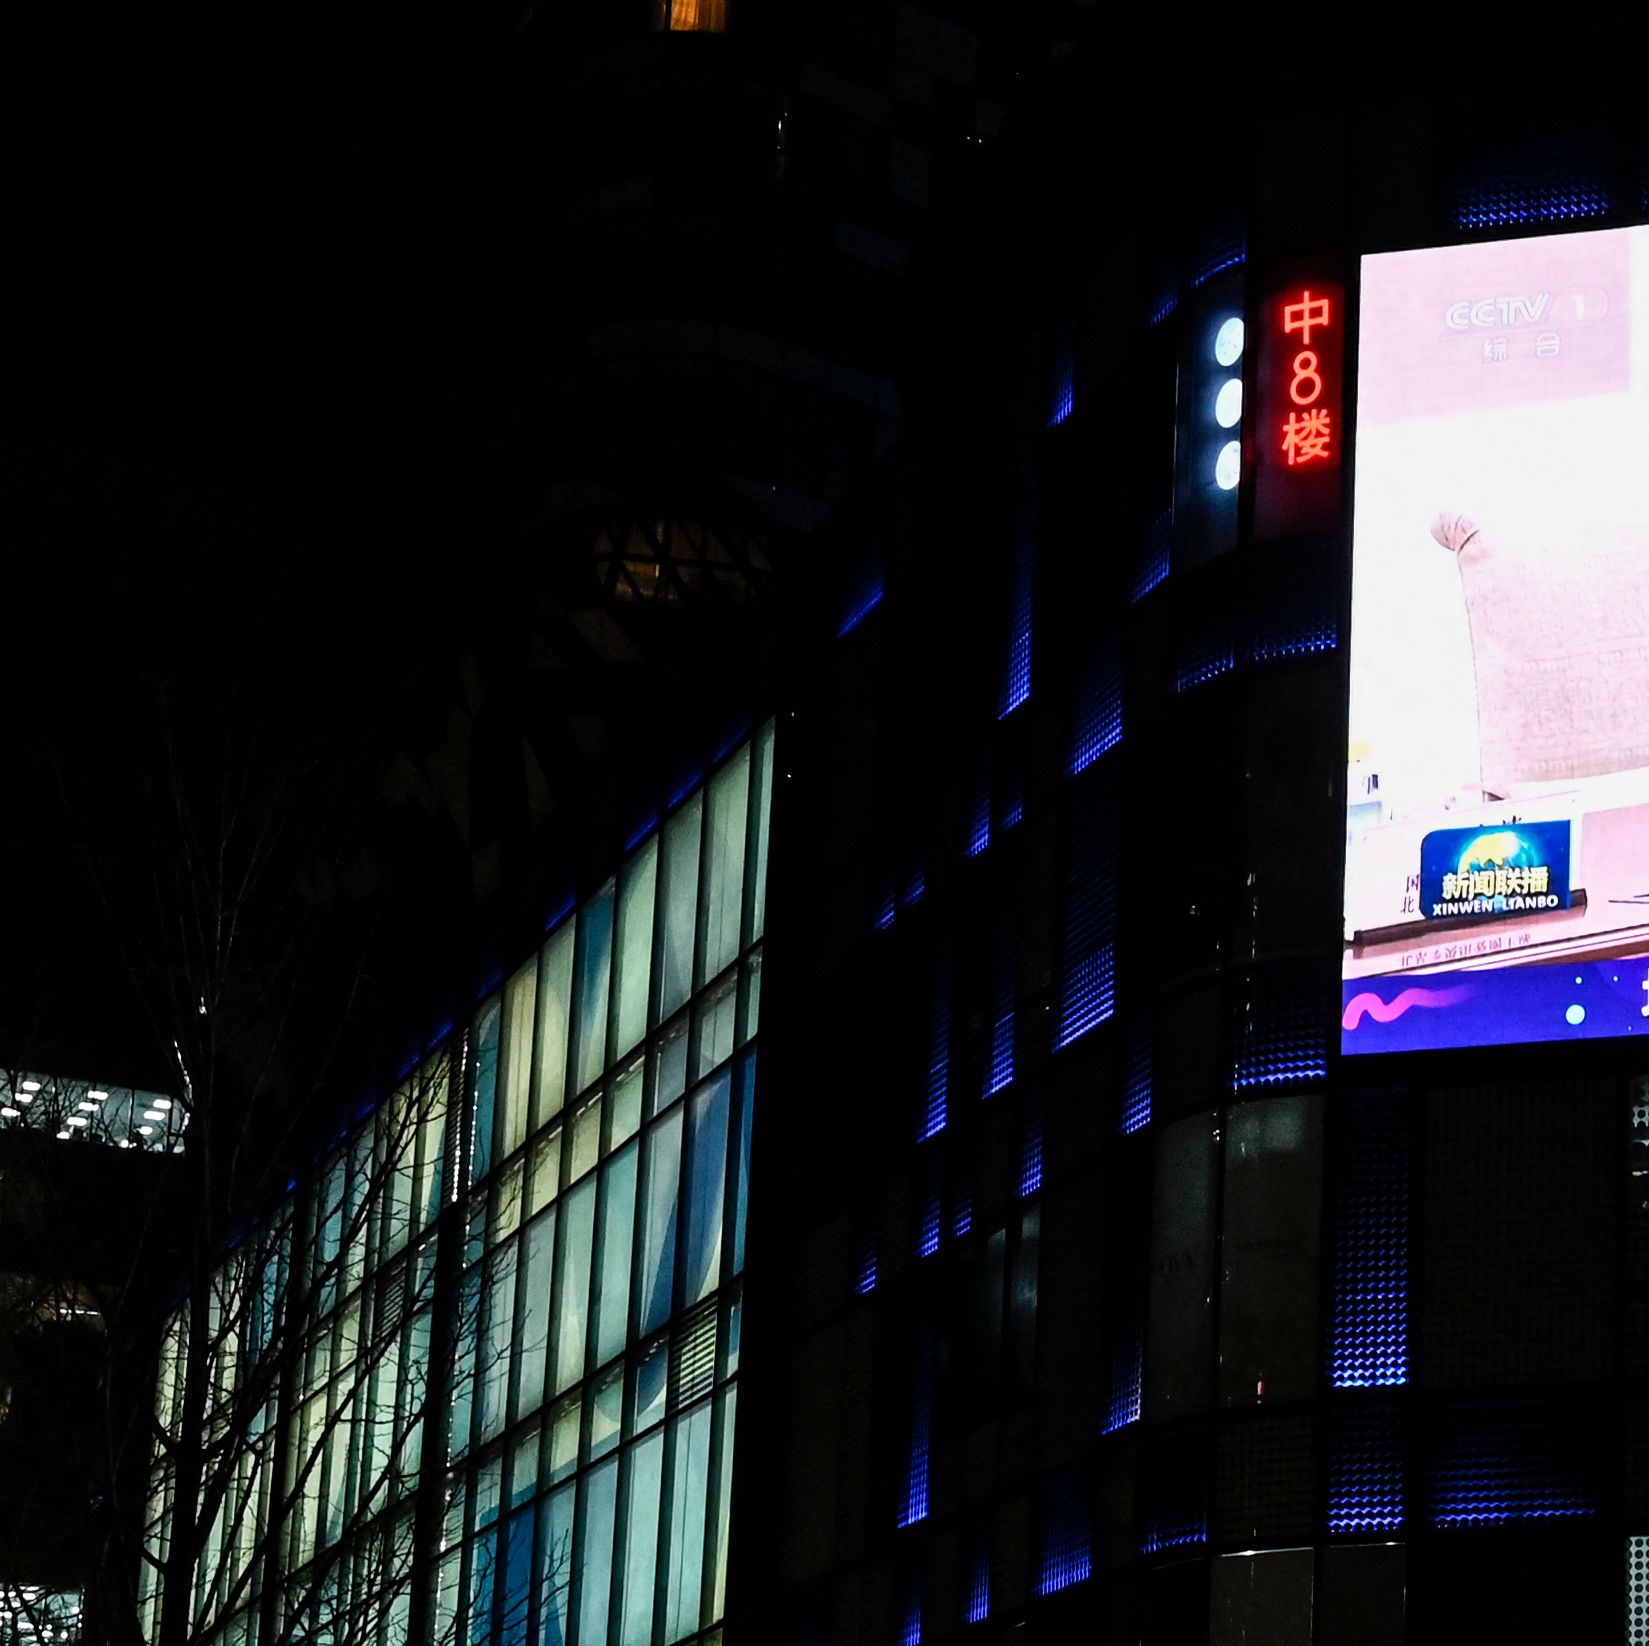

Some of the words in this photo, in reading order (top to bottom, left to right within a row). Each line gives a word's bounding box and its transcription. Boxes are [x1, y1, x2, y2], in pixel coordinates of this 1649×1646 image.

[1444, 293, 1549, 330] CCTV
[1281, 290, 1332, 467] 中8楼
[1441, 866, 1549, 901] 新闻联播
[1432, 899, 1494, 917] XINWEN
[1502, 894, 1560, 911] LIANBO
